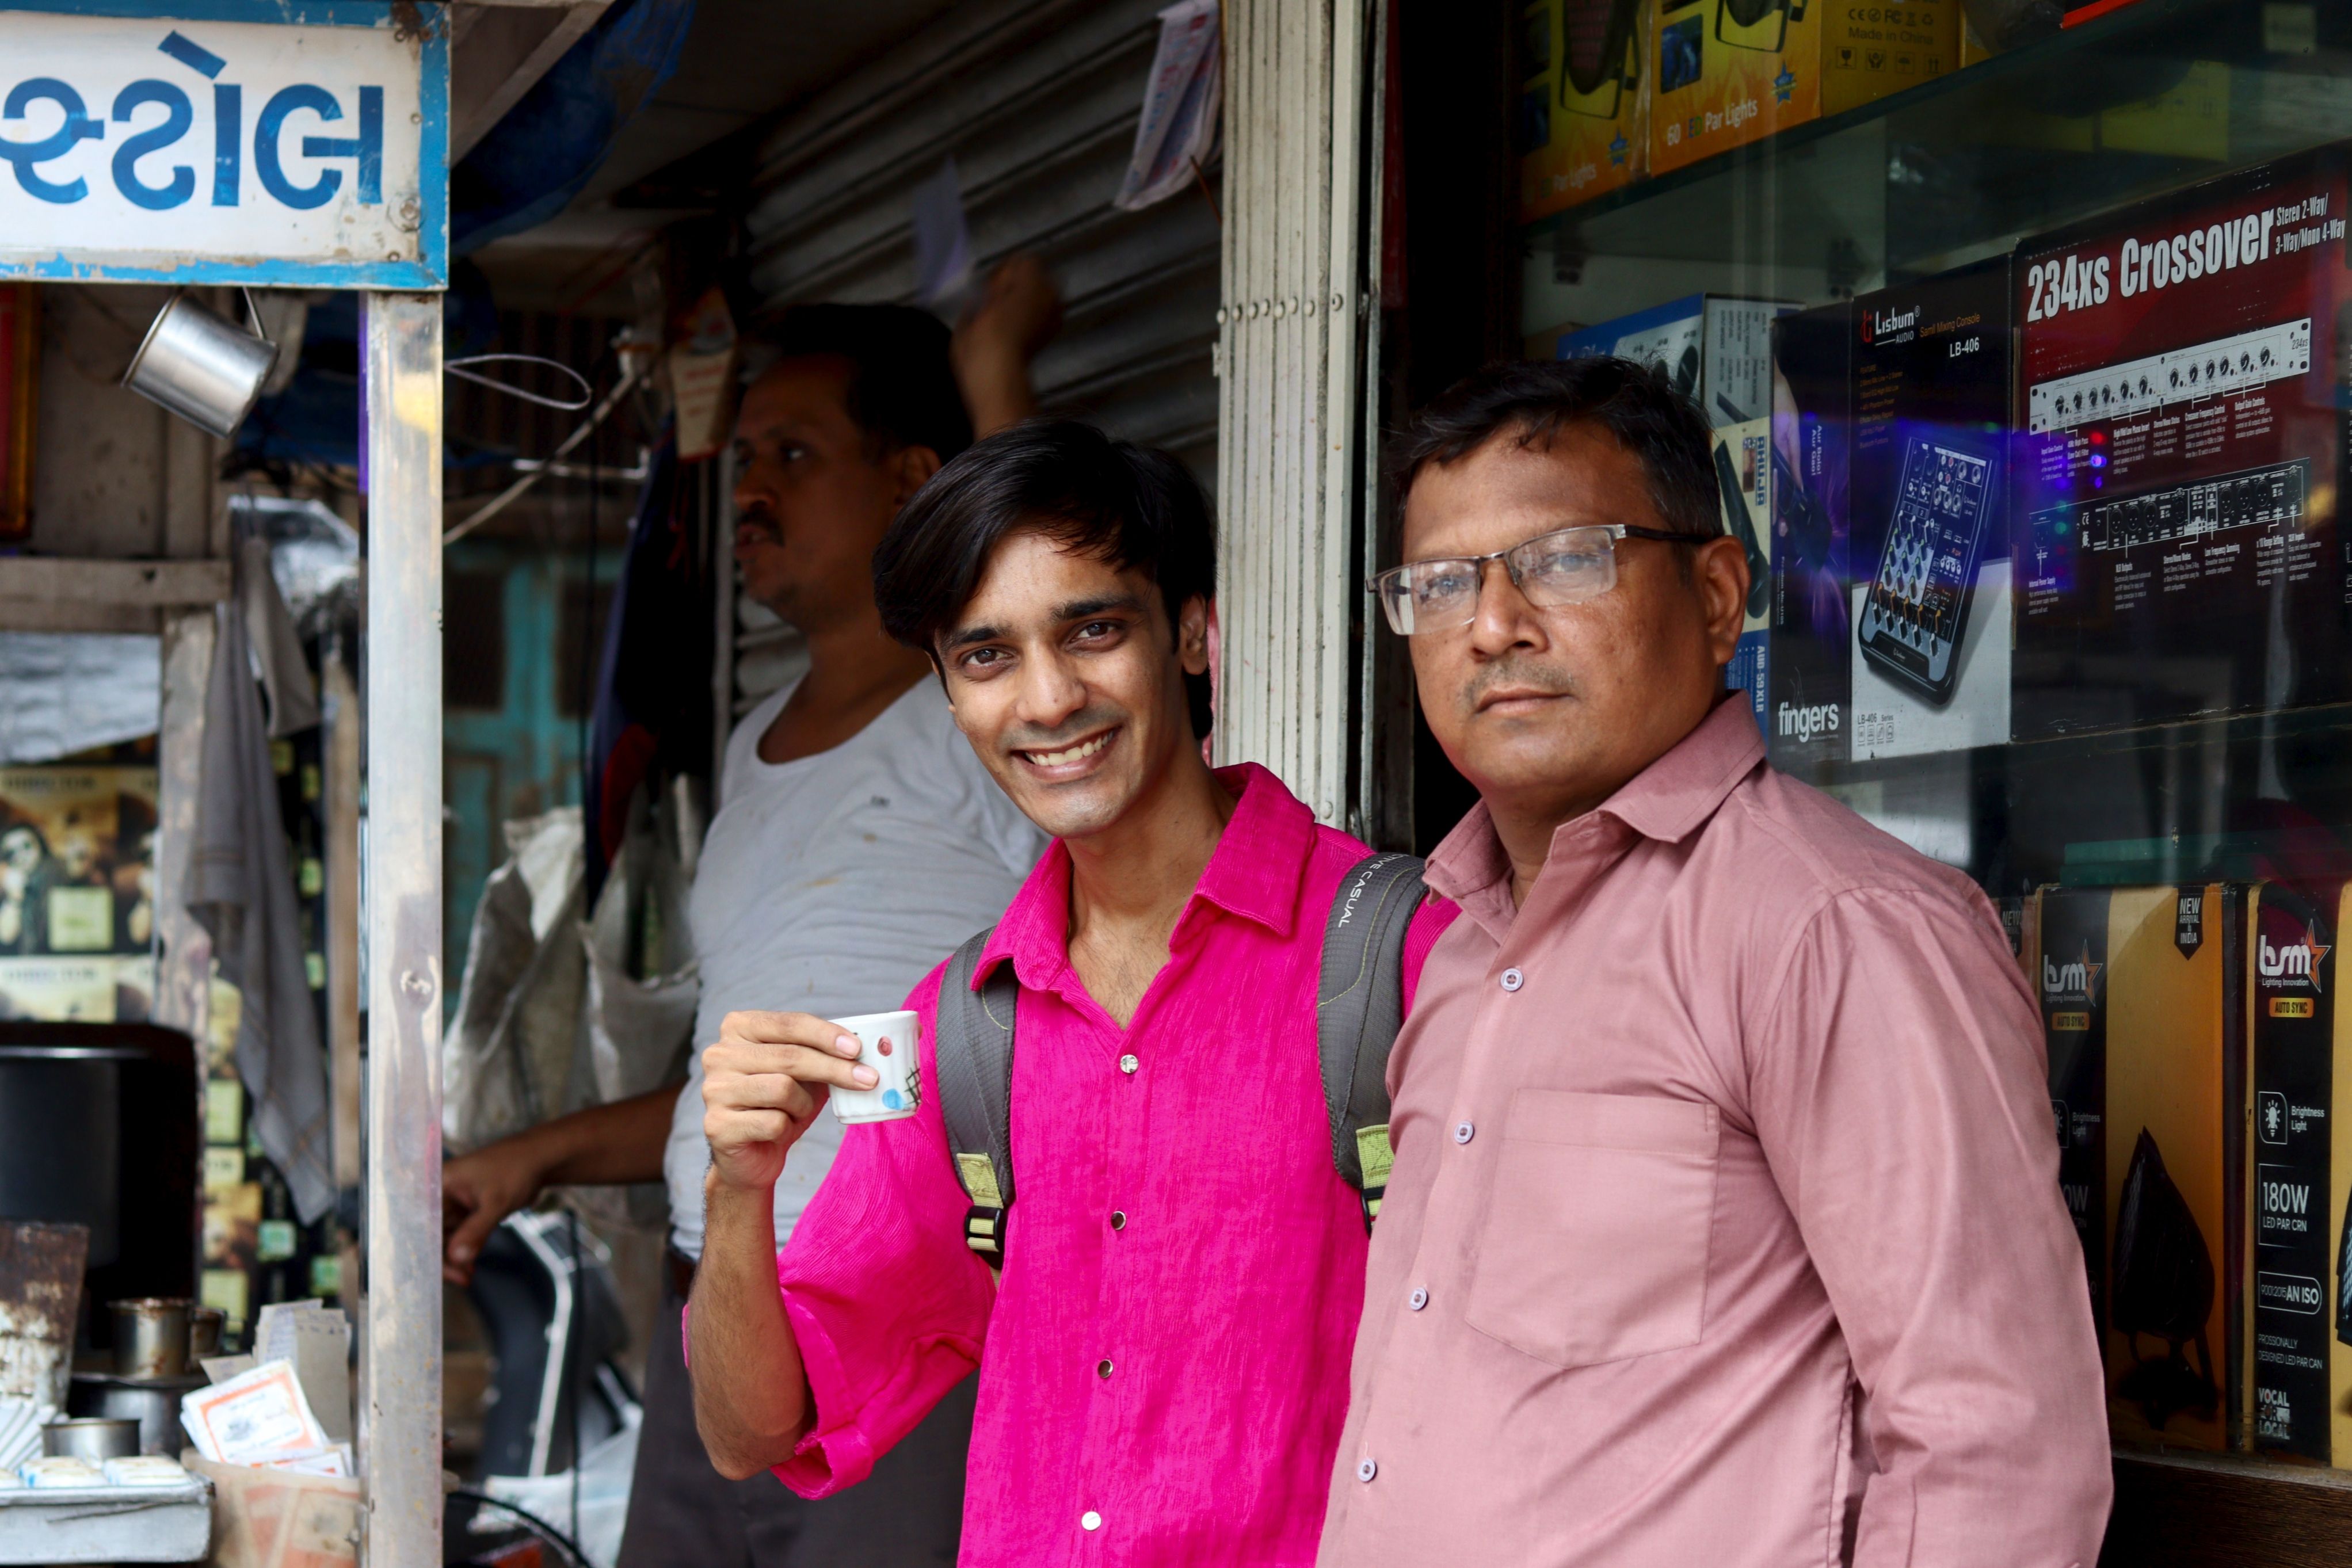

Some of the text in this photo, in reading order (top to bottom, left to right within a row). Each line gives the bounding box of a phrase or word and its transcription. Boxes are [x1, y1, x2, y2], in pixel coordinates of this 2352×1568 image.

[1849, 26, 1934, 45] Made in China
[1705, 111, 1723, 133] Par
[1725, 99, 1758, 128] Lights
[2276, 193, 2328, 227] Stereo 2-Way/
[2275, 219, 2346, 255] 3-Way/Mono 4-Way
[2027, 208, 2275, 322] 234xs Crossover
[1875, 307, 1915, 335] Lisburn
[1937, 321, 1955, 333] Mixing
[1956, 312, 1980, 327] Console
[1896, 330, 1914, 344] AUDIO
[1950, 337, 1979, 358] LB-406
[1757, 436, 1766, 506] AHUJA
[1778, 701, 1839, 743] fingers
[1858, 713, 1877, 724] LB-406
[1338, 871, 1373, 928] CASUAL
[2179, 898, 2201, 914] NEW
[2180, 932, 2198, 944] INDIA
[2259, 934, 2311, 976] bsm
[2044, 955, 2087, 993] bsm
[2262, 978, 2309, 988] Lighting Innovation
[2046, 994, 2063, 1004] Lighting
[2275, 1002, 2308, 1013] AUTO SYNC
[2072, 1112, 2101, 1124] Brightness
[2291, 1105, 2325, 1120] Brightness
[2072, 1126, 2086, 1137] Light
[2291, 1120, 2307, 1132] Light
[2263, 1182, 2309, 1214] 180W
[2263, 1216, 2275, 1228] LED
[2277, 1218, 2290, 1230] PAR
[2286, 1285, 2300, 1302] AN
[2302, 1287, 2319, 1304] ISO
[2258, 1350, 2323, 1369] DESIGNED LED PAR CAN
[2258, 1387, 2290, 1407] VOCAL
